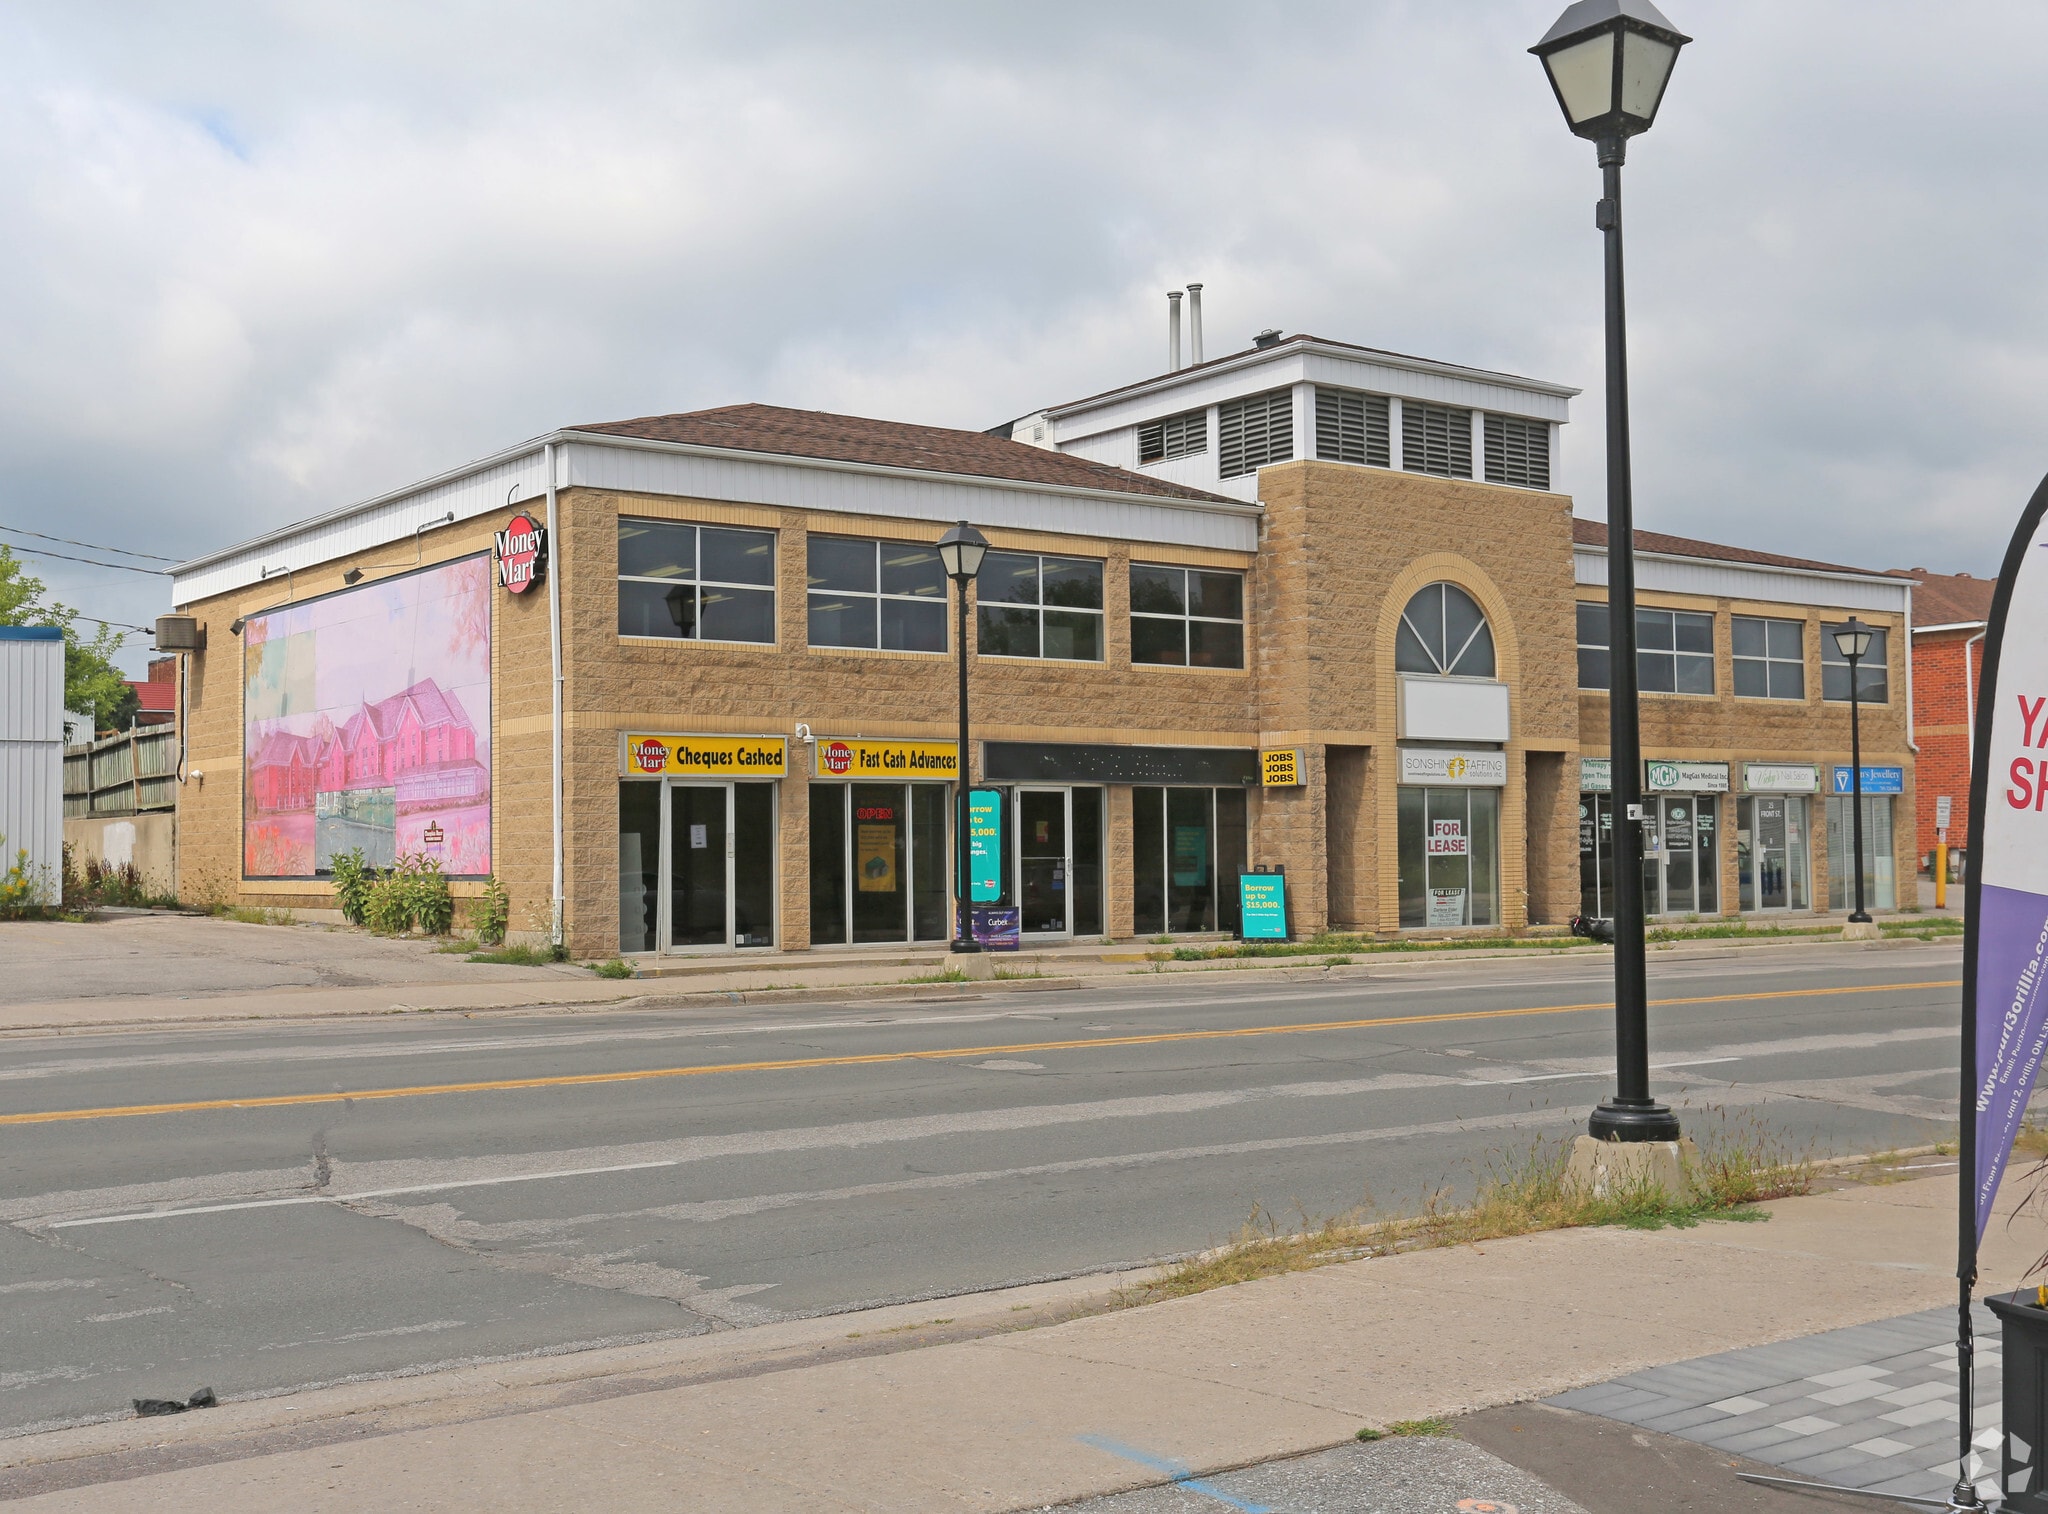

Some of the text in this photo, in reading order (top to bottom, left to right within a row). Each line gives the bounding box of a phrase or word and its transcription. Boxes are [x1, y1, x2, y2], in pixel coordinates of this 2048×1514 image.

[494, 529, 544, 559] Money
[498, 556, 536, 587] Mart
[630, 743, 783, 769] Money Cheques Cashed
[633, 755, 667, 768] Mart
[819, 745, 957, 769] Money Fast Cash Advances
[1265, 753, 1293, 762] JOBS
[822, 757, 852, 770] Mart
[1265, 763, 1294, 773] JOBS
[1405, 757, 1503, 771] SONSHINE STAFFING
[1265, 773, 1294, 783] JOBS
[1469, 770, 1493, 778] solutions
[1651, 766, 1678, 786] MGM
[1701, 772, 1719, 780] Medical
[1870, 769, 1900, 781] Jewellery
[857, 807, 893, 820] OPEN
[1760, 810, 1775, 818] FRONT
[1434, 823, 1460, 836] FOR
[1427, 839, 1466, 853] LEASE
[1245, 893, 1256, 901] up
[987, 918, 1008, 926] Curbex
[2000, 1058, 2016, 1084] Email:
[1982, 1165, 1998, 1192] Front
[2006, 1098, 2019, 1119] Unit
[2018, 1057, 2037, 1086] Orillia
[2031, 1039, 2044, 1056] ON
